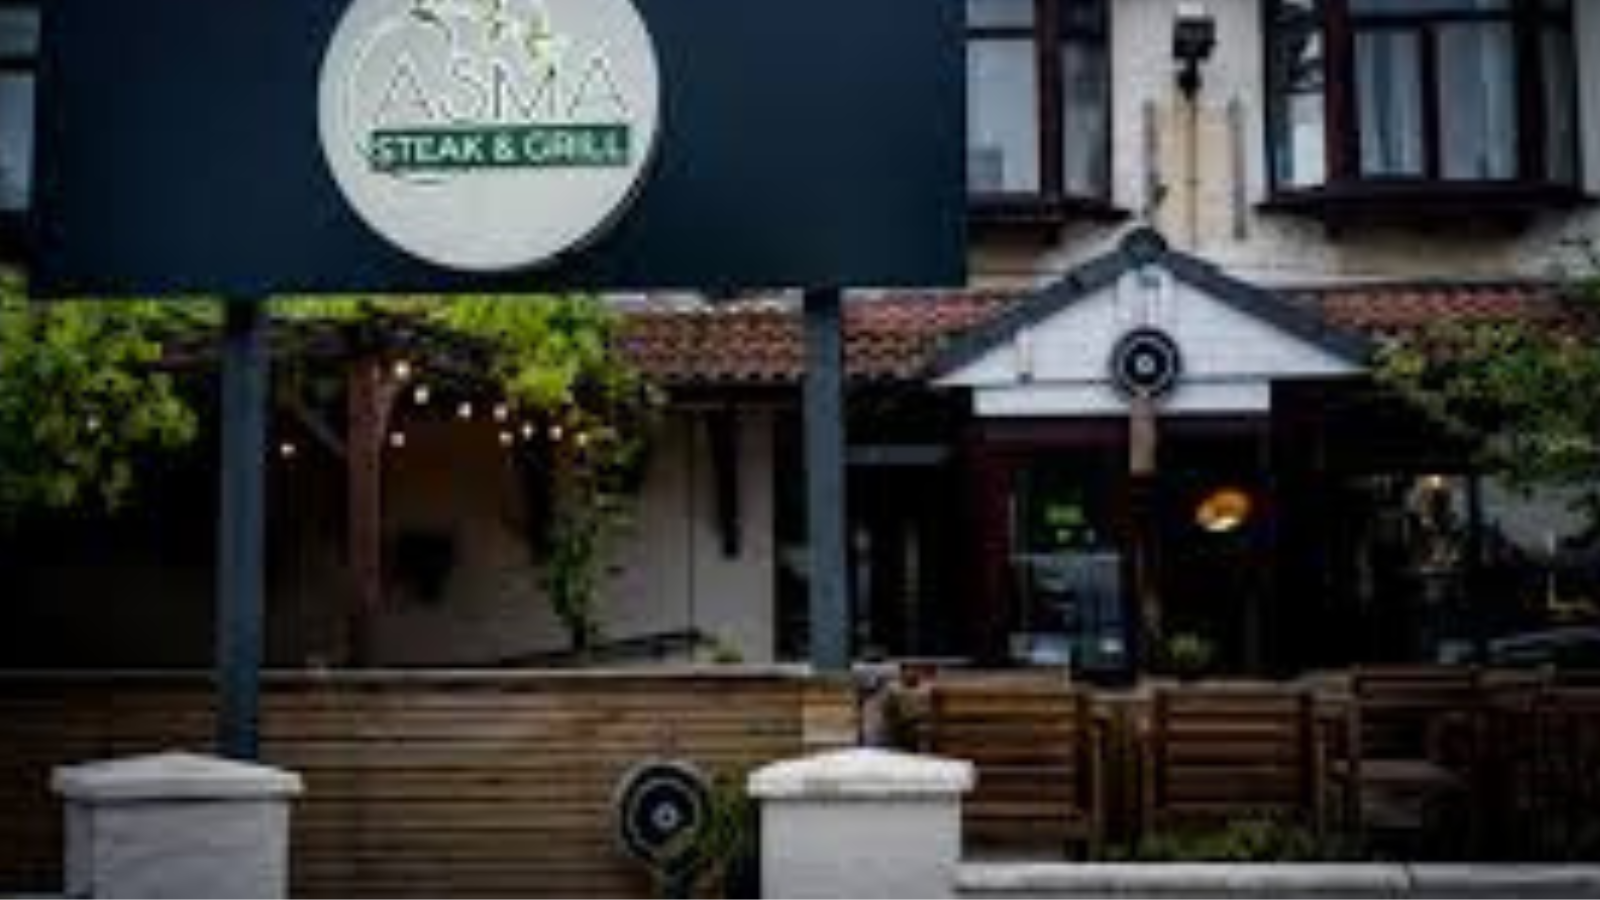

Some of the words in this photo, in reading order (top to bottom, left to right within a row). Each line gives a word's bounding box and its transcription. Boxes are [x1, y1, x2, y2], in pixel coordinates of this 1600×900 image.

[374, 54, 630, 122] ASMA
[375, 136, 485, 164] STEAK
[494, 136, 520, 162] &
[523, 130, 626, 162] GRILL
